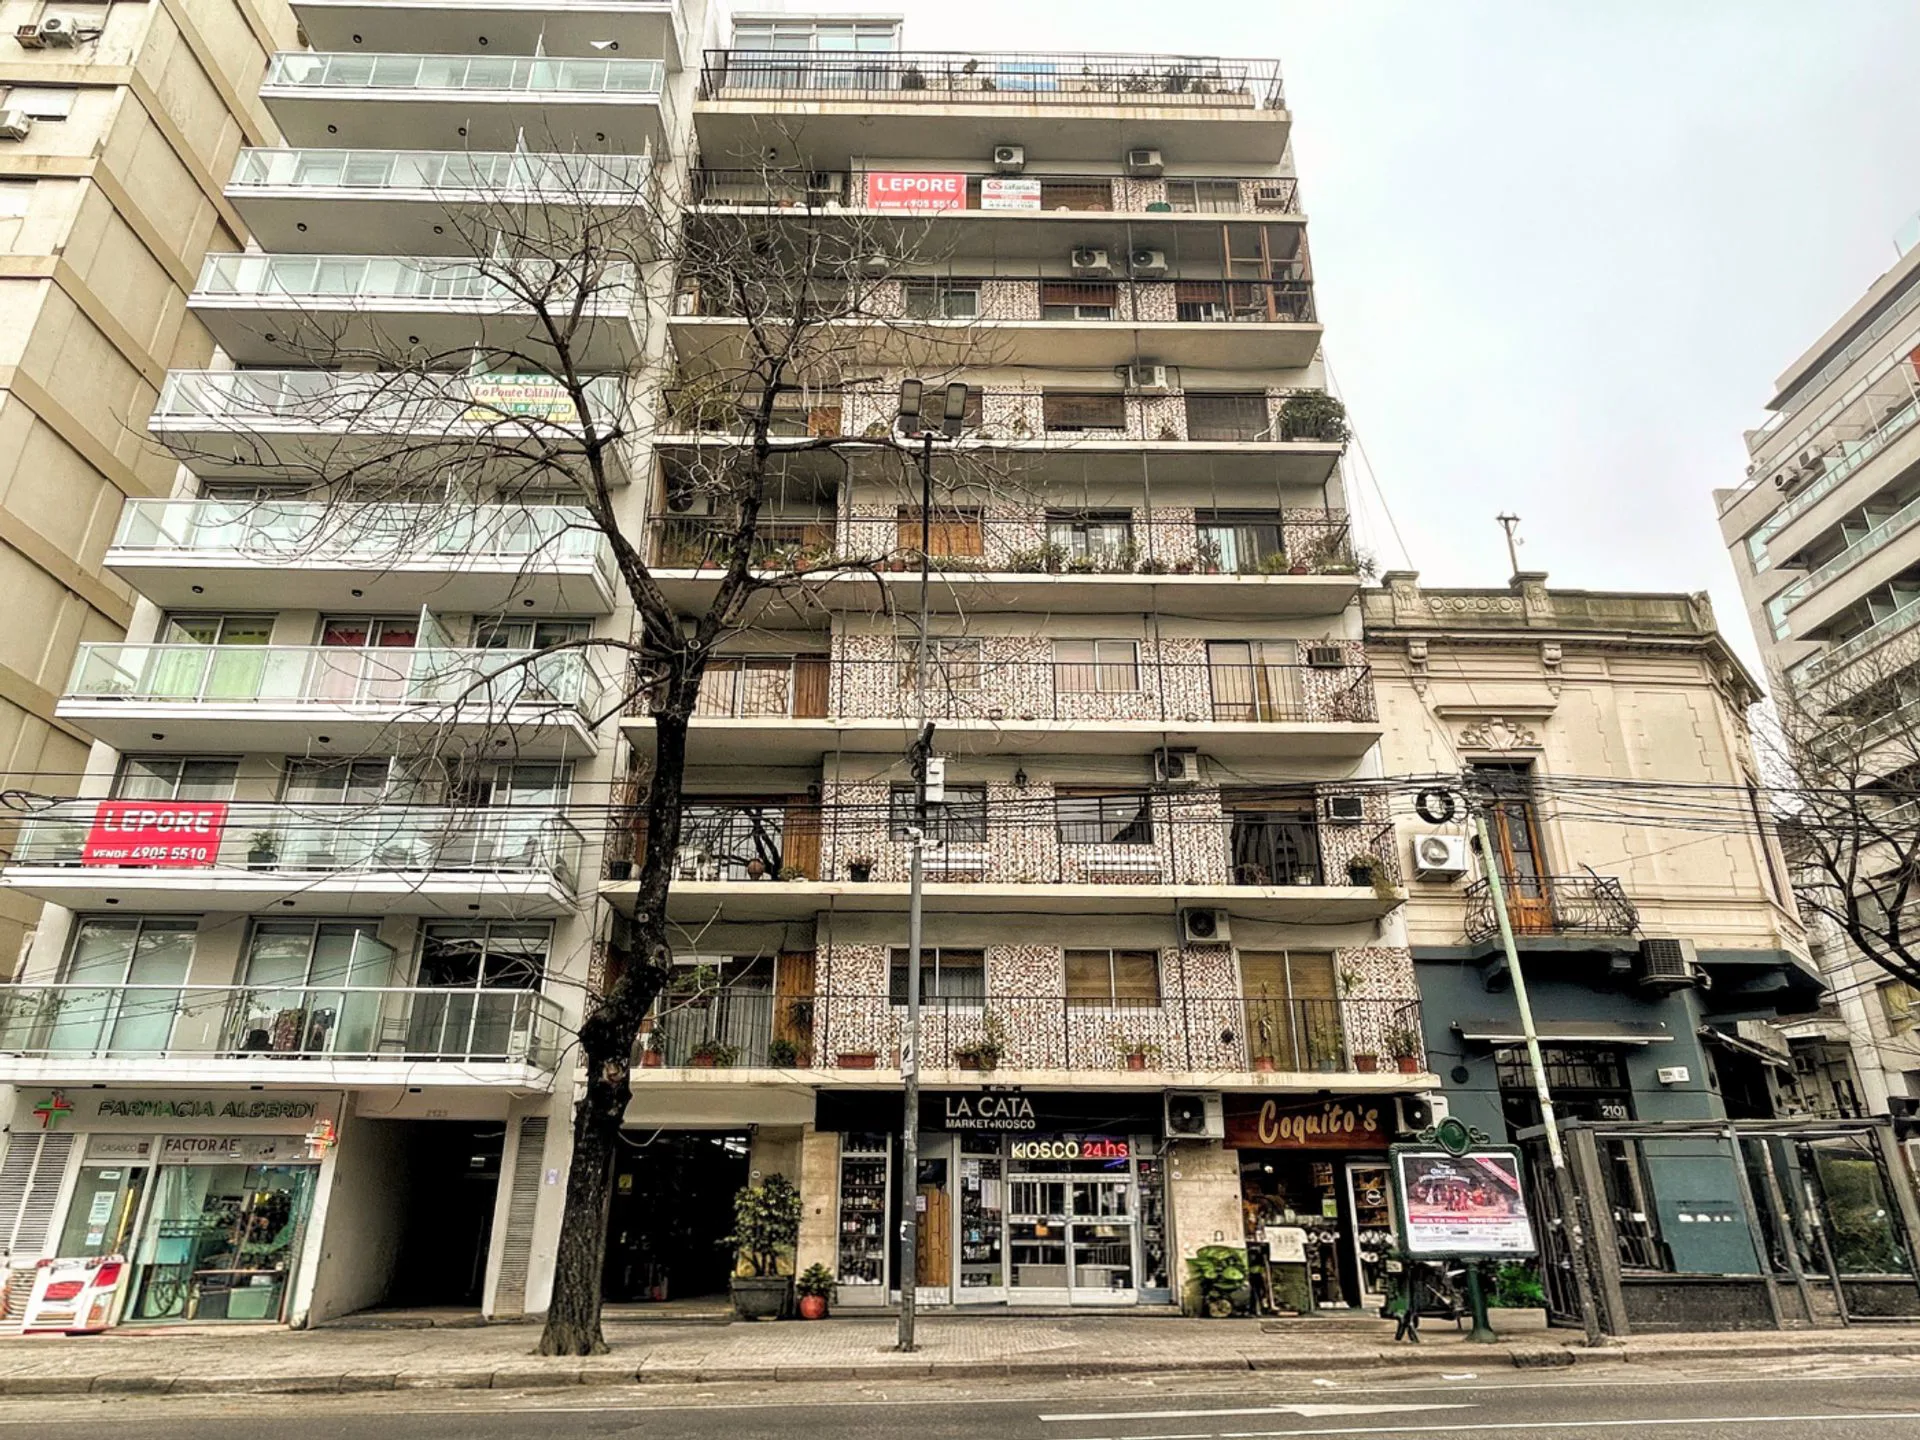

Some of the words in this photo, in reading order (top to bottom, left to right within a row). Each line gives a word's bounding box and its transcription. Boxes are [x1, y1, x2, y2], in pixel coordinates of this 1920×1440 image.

[877, 178, 957, 192] LEPORE
[103, 809, 213, 833] LEPORE
[131, 847, 168, 859] 4905
[171, 847, 207, 860] 5510
[98, 1099, 214, 1118] FARMACIA
[219, 1101, 318, 1118] ALBERDI
[945, 1097, 973, 1118] LA
[977, 1097, 1035, 1118] CATA
[1601, 1105, 1625, 1117] 2101
[1258, 1099, 1379, 1144] Coquito's
[164, 1138, 216, 1151] FACTOR
[1011, 1141, 1079, 1159] KIOSCO
